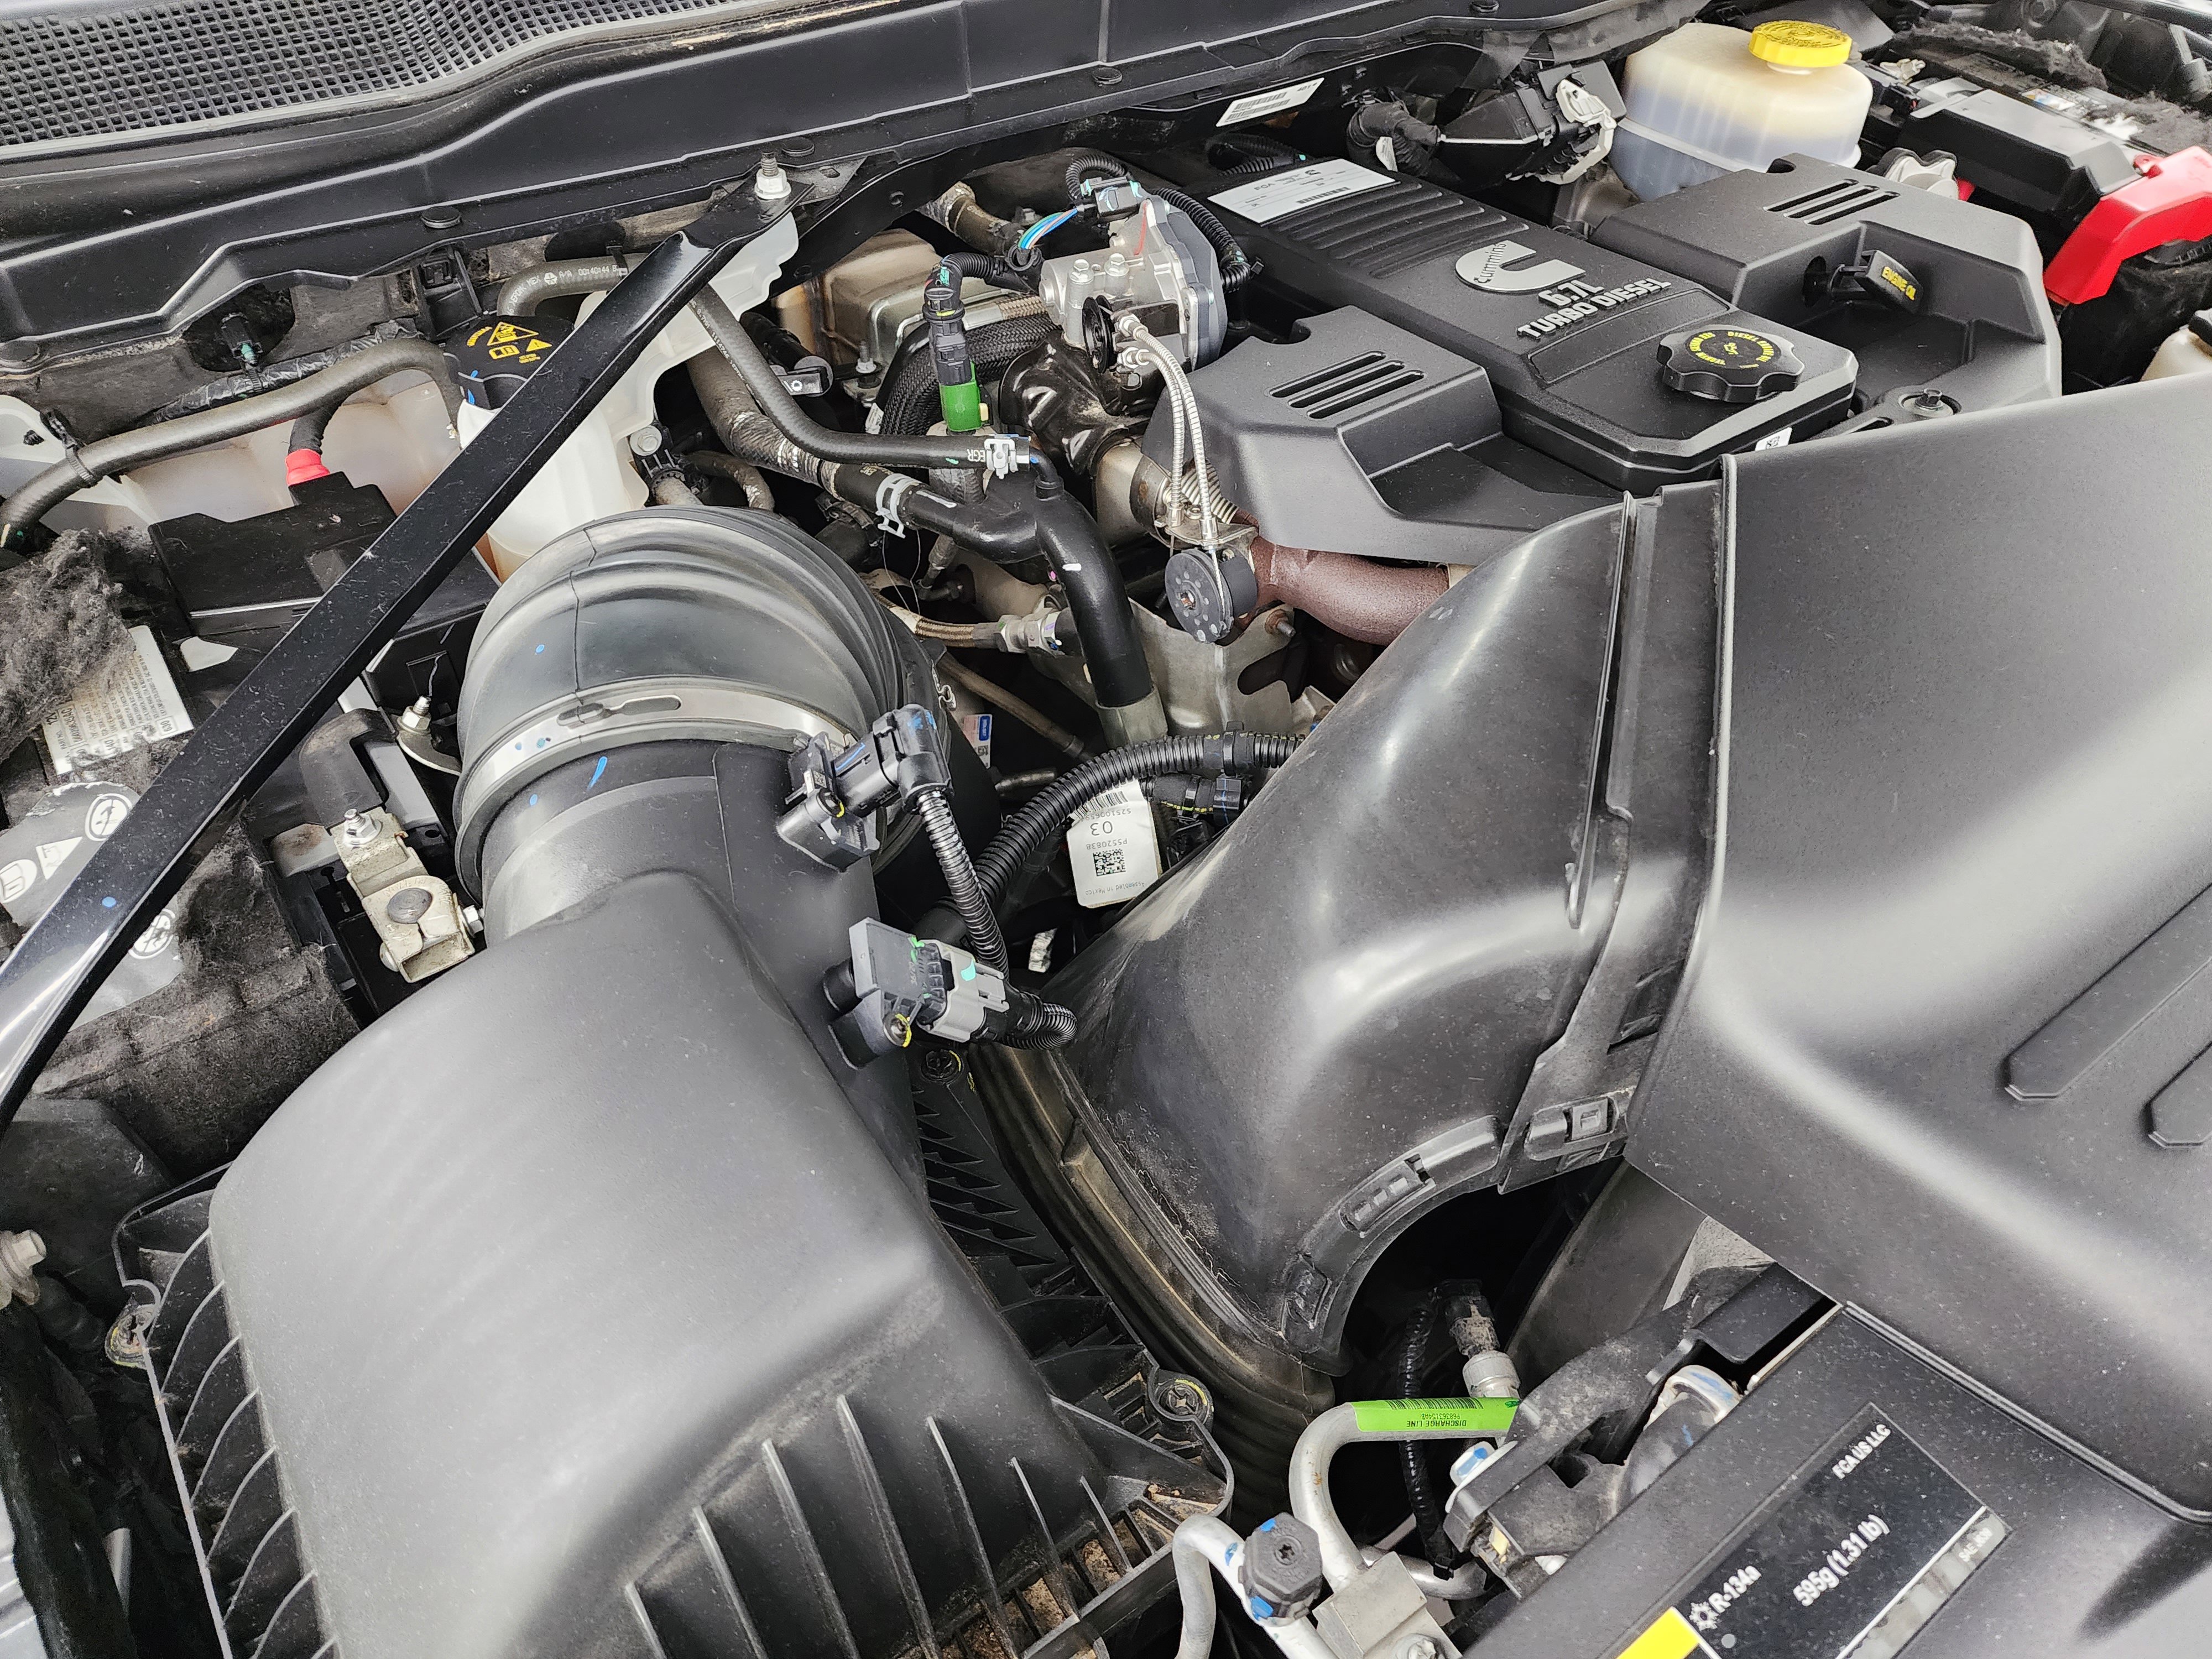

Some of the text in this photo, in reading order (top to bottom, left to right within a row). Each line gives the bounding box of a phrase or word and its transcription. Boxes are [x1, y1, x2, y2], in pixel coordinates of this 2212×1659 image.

[1538, 278, 1605, 308] 6.7L
[1517, 278, 1672, 340] TURBO DIESEL
[967, 448, 986, 463] EGR
[1089, 821, 1113, 836] 03
[1086, 838, 1128, 850] P5520838
[1832, 1423, 1891, 1480] FCA US LLC
[1793, 1514, 1890, 1607] 595g (1.31 lb)
[1958, 1543, 1980, 1563] SAE
[1708, 1565, 1762, 1613] R-134a
